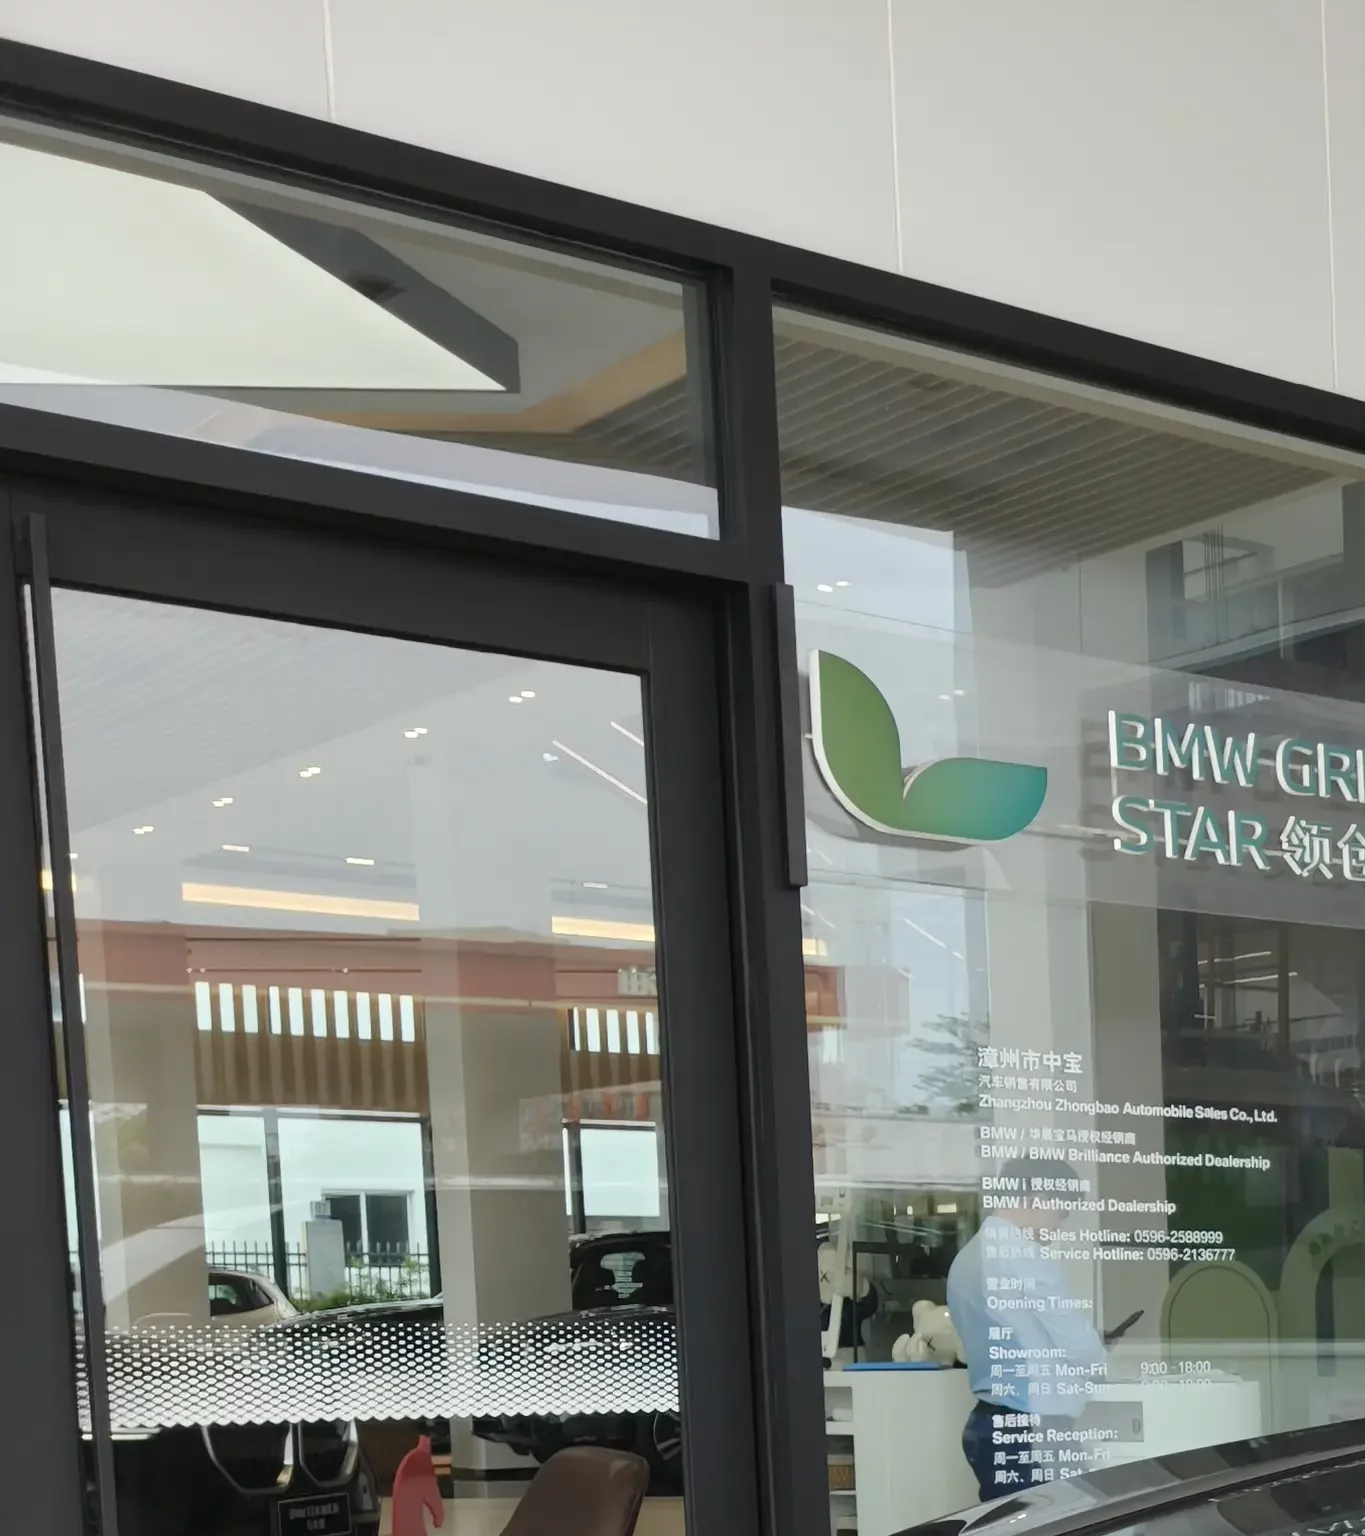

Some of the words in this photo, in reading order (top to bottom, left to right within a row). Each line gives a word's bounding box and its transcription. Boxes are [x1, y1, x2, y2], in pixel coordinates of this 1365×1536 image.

[1108, 709, 1260, 788] BMW
[1111, 795, 1272, 872] STAR
[977, 1046, 1084, 1074] 漳州市中宝
[977, 1075, 1078, 1093] 汽车销售有限公司
[979, 1094, 1052, 1113] Zhangzhou
[1055, 1098, 1119, 1115] Zhongbao
[1123, 1102, 1194, 1118] Automobile
[1195, 1106, 1228, 1120] Sales
[980, 1127, 1018, 1141] BMW
[981, 1145, 1019, 1159] BMW
[1029, 1147, 1065, 1161] BMW
[1068, 1148, 1130, 1164] Brilliance
[1133, 1151, 1202, 1167] Authorized
[1205, 1154, 1271, 1171] Dealership
[982, 1177, 1020, 1191] BMW
[1030, 1177, 1091, 1193] 授权经销商
[983, 1195, 1020, 1210] BMW
[1032, 1197, 1105, 1212] Authorized
[1108, 1198, 1176, 1215] Dealership
[1039, 1228, 1076, 1243] Sales
[1080, 1229, 1131, 1244] Hotline:
[1134, 1230, 1224, 1245] 0596-2588999
[1039, 1247, 1089, 1261] Service
[1092, 1247, 1144, 1261] Hotline:
[1147, 1247, 1236, 1262] 0596-2136777
[987, 1296, 1045, 1312] Opening
[1047, 1296, 1093, 1310] Times:
[988, 1326, 1014, 1341] 展厅
[989, 1346, 1066, 1360] Showroom:
[990, 1363, 1051, 1379] 周一至周五
[1055, 1363, 1108, 1378] Mon-Fri
[1140, 1361, 1168, 1375] 9:00
[1178, 1360, 1211, 1374] 18:00
[1056, 1381, 1107, 1396] Sat-Sun
[992, 1430, 1044, 1445] Service
[1047, 1428, 1119, 1443] Reception:
[993, 1450, 1054, 1466] 周一至周五
[1058, 1448, 1111, 1463] Mon-Fri
